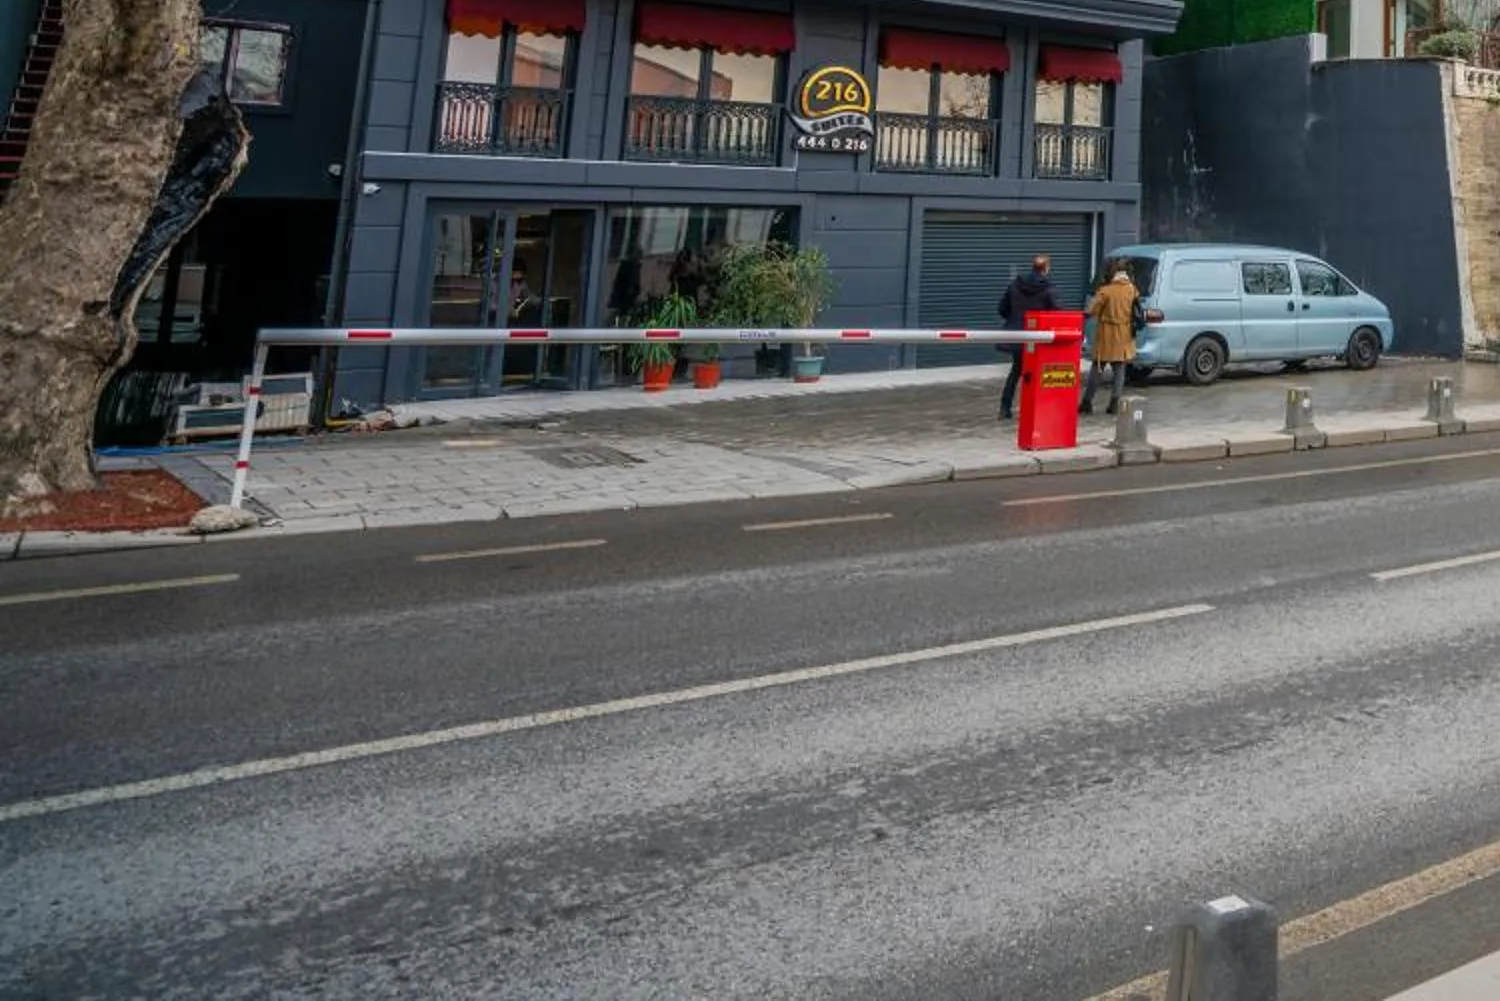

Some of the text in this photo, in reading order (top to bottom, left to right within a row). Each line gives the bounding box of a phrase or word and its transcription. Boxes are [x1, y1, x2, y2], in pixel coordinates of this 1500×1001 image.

[816, 81, 858, 102] 216
[797, 135, 826, 148] 444
[845, 138, 867, 150] 216
